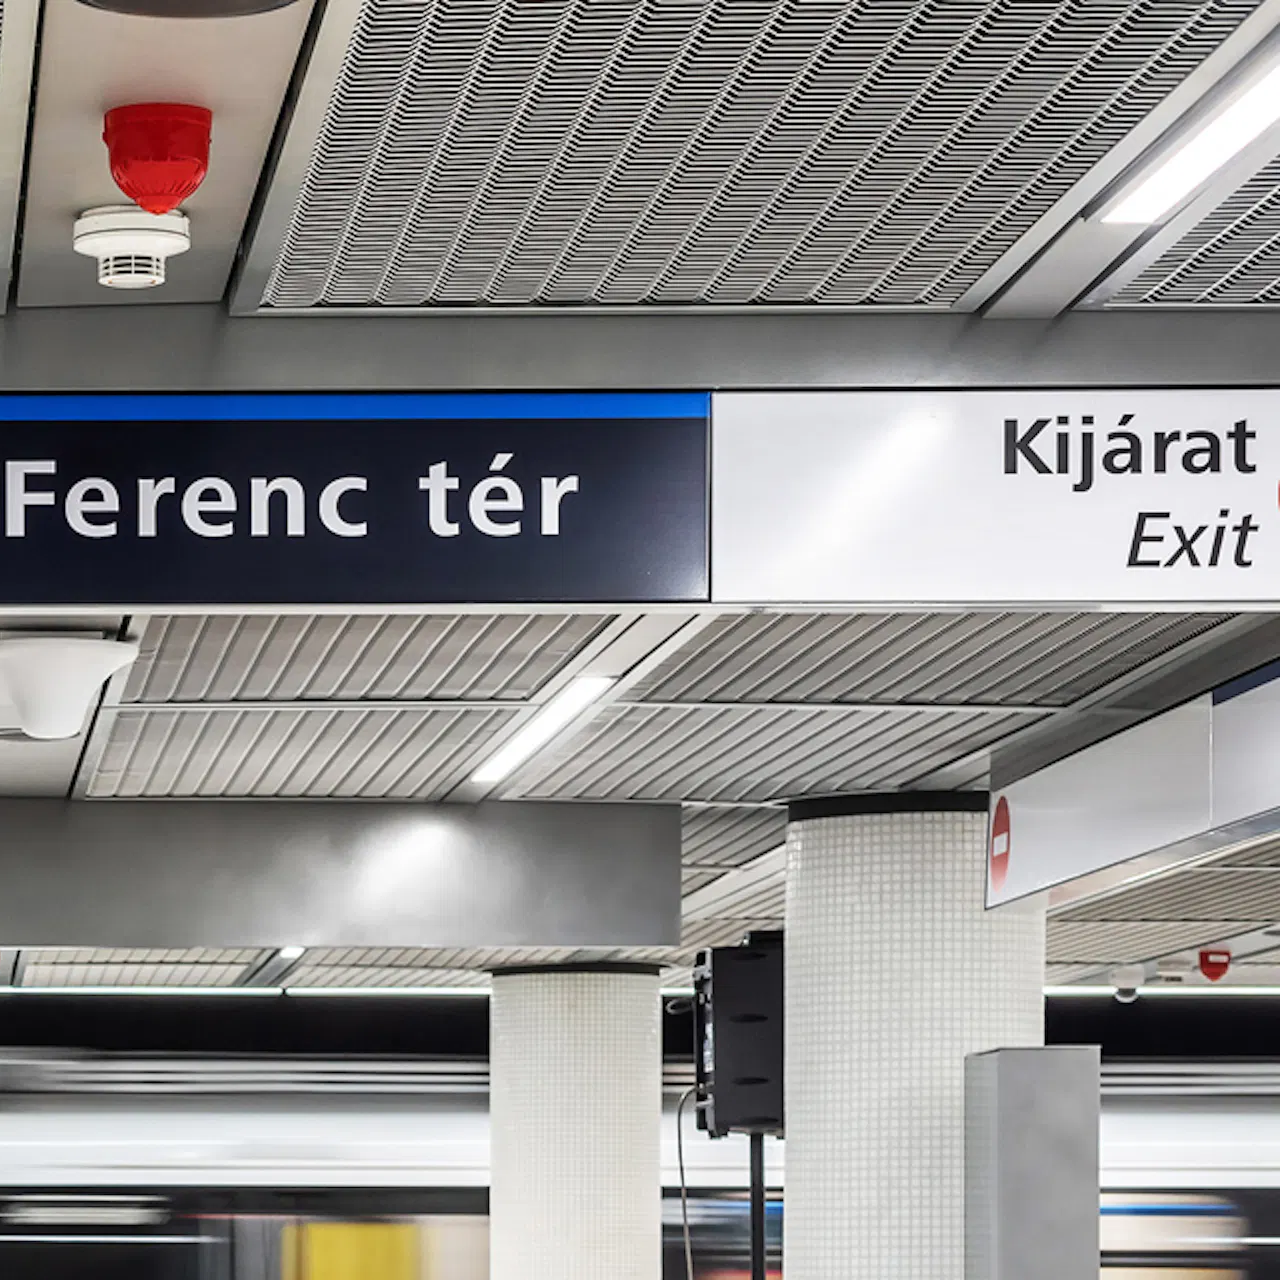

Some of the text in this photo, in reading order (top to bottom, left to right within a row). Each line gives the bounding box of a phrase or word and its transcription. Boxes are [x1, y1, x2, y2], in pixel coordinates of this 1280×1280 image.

[1003, 413, 1258, 493] Kijárat
[5, 460, 369, 539] Ferenc
[418, 452, 580, 538] tér
[1126, 508, 1261, 569] Exit
